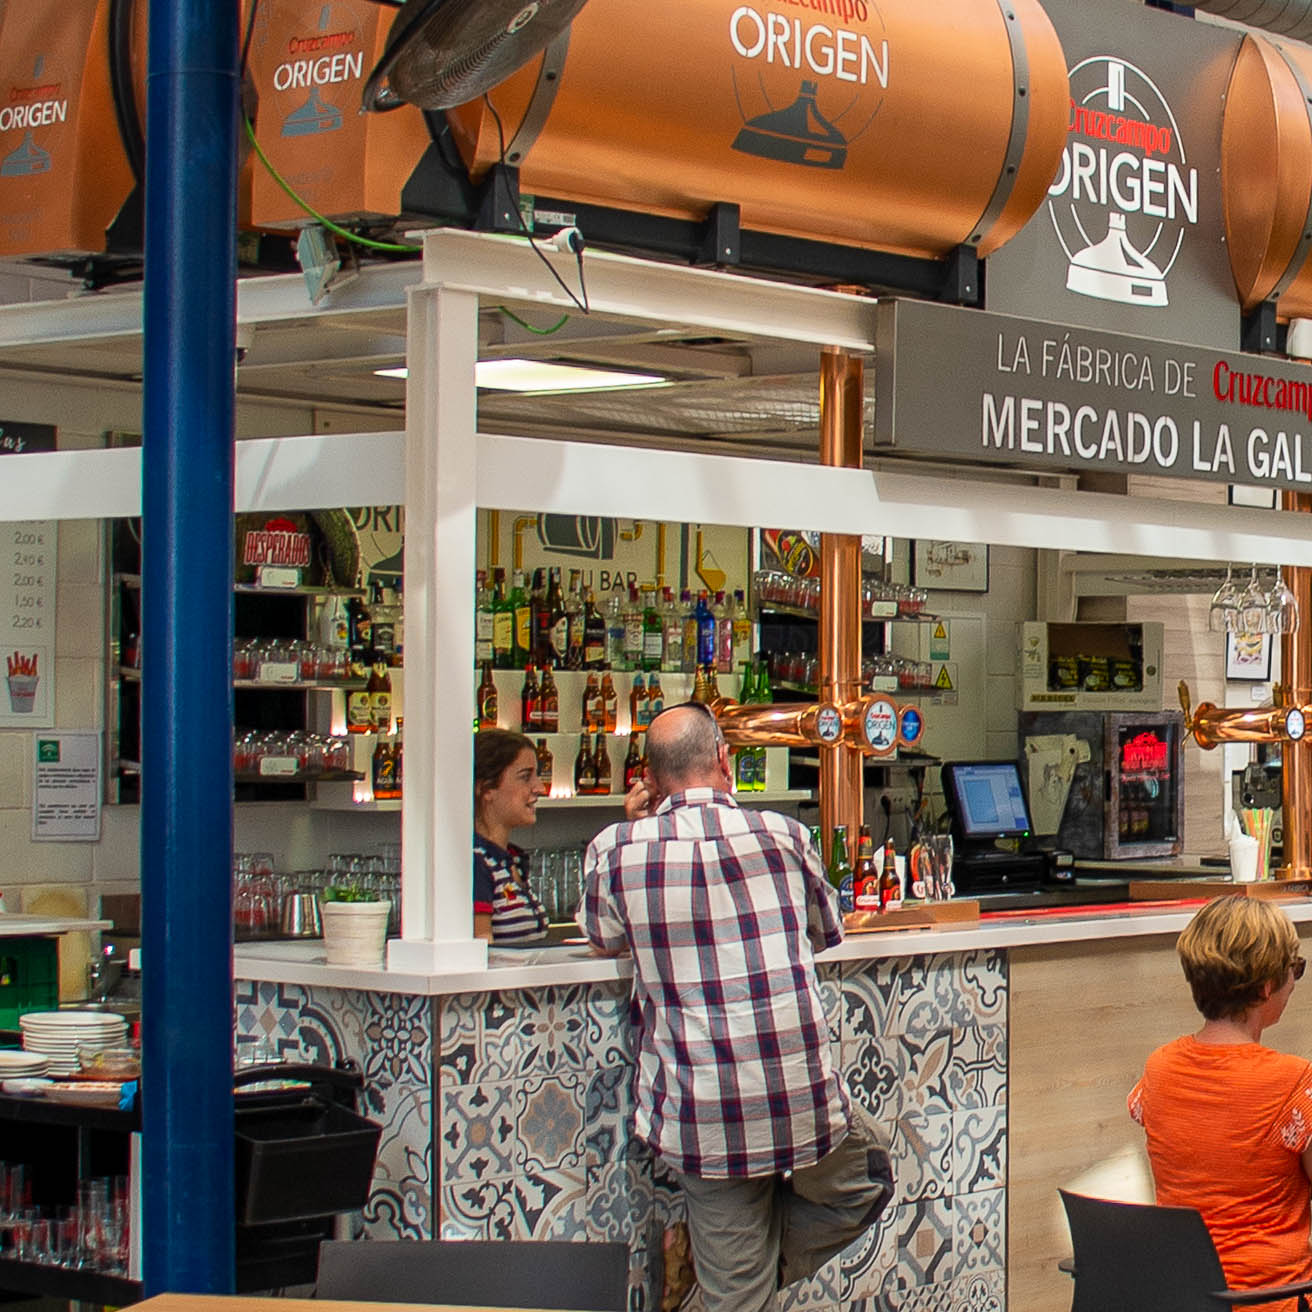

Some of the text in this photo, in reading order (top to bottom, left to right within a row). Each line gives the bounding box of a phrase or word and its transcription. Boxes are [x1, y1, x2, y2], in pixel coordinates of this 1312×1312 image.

[729, 6, 889, 89] ORIGEN
[273, 51, 364, 92] ORIGEN
[0, 99, 68, 131] ORIGEN
[997, 333, 1031, 375] LA
[1041, 331, 1155, 392] FÁBRICA
[1164, 359, 1197, 398] DE
[981, 392, 1180, 469] MERCADO
[1192, 419, 1236, 475] LA
[243, 530, 311, 568] DESPERADOS
[599, 570, 638, 593] BAR
